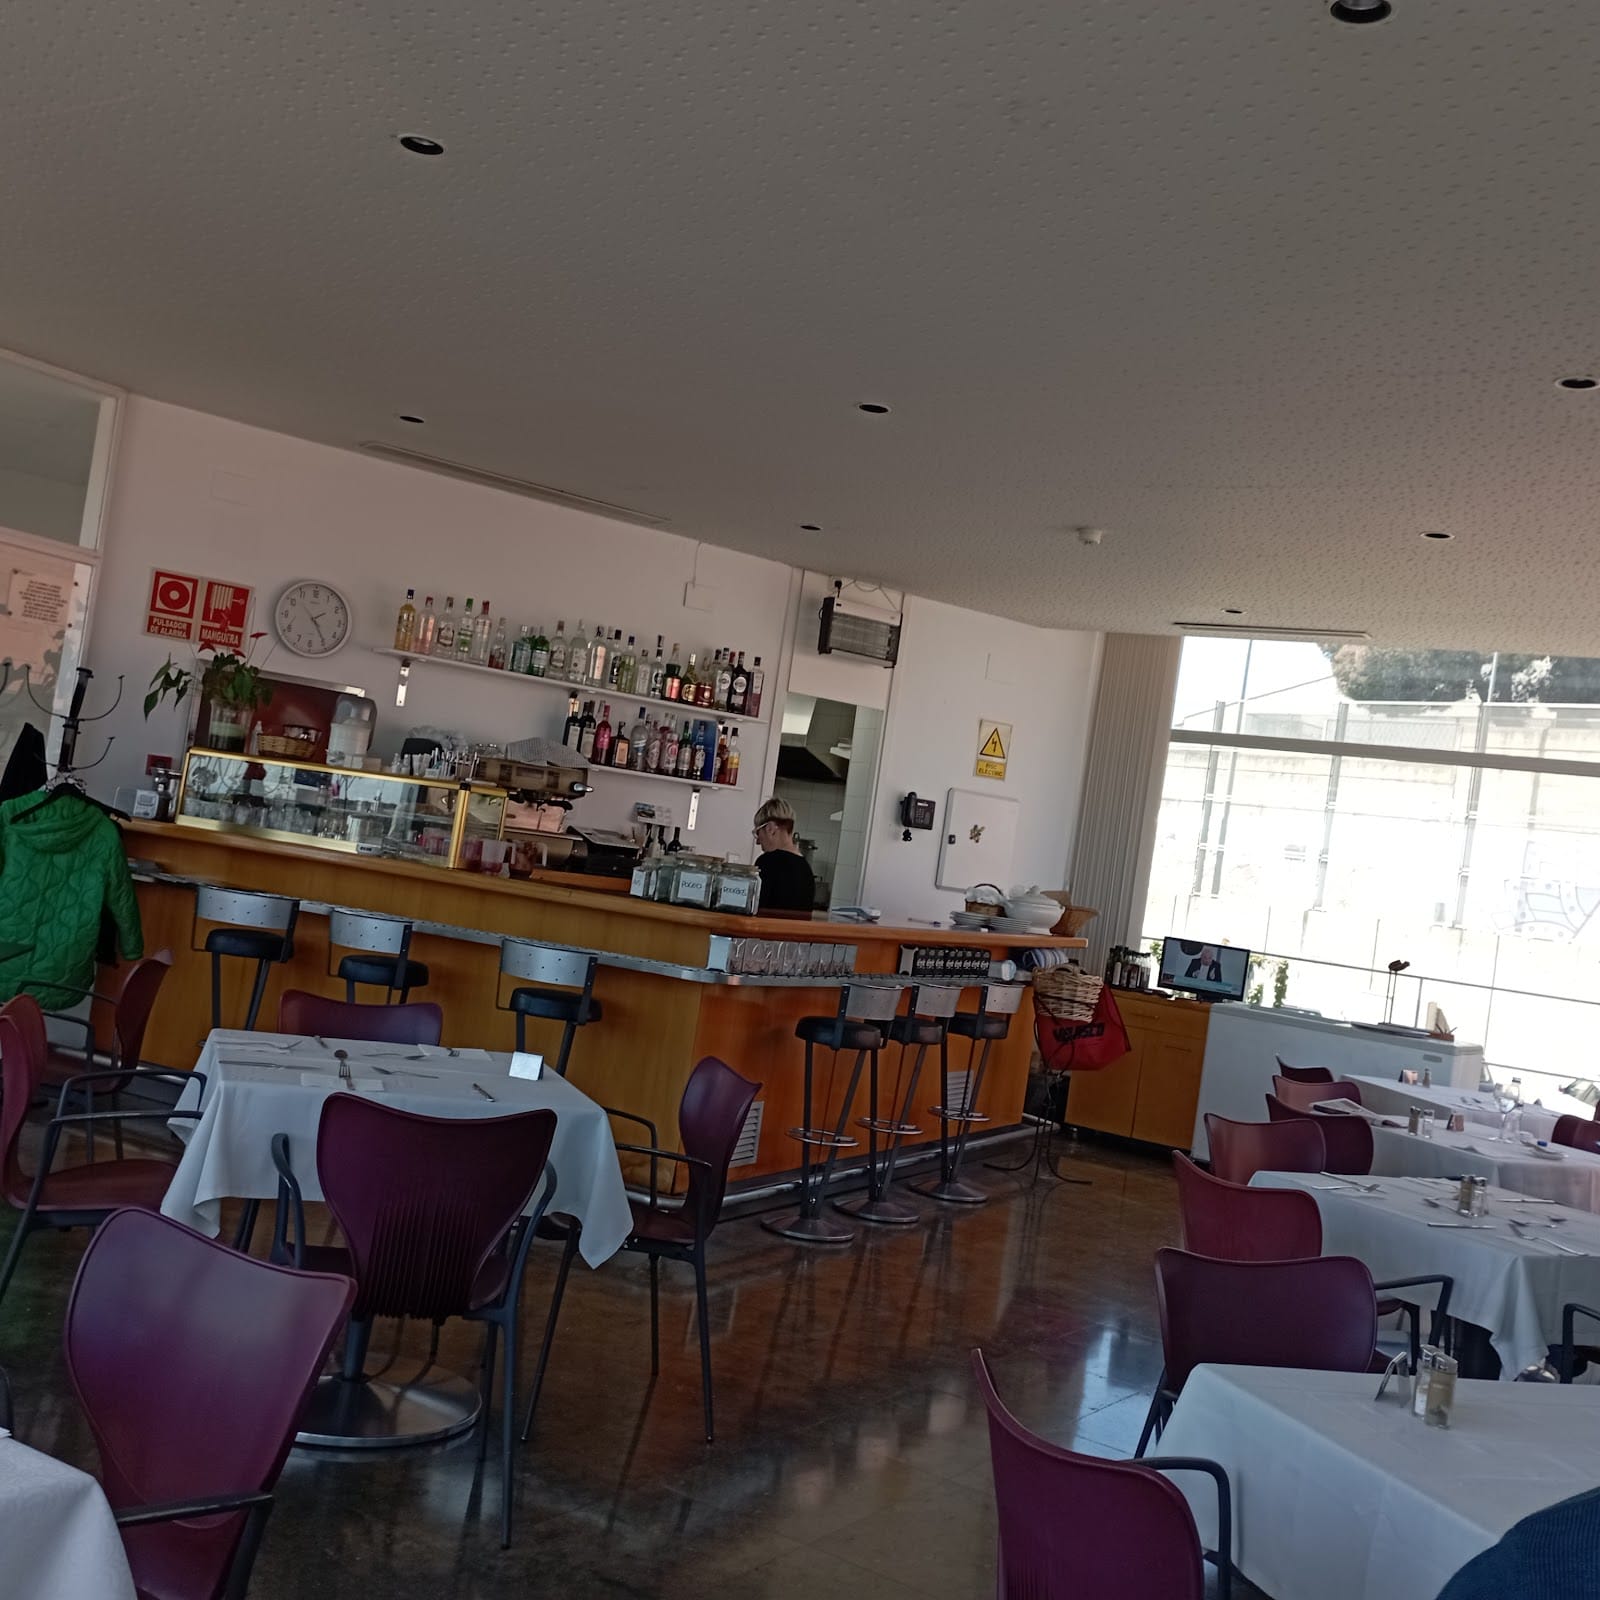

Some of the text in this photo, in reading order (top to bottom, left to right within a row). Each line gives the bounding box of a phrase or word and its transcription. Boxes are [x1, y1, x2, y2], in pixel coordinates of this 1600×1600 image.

[152, 617, 188, 630] PULSADOR
[150, 625, 188, 638] DE ALARMA
[201, 628, 240, 645] MANGUERA
